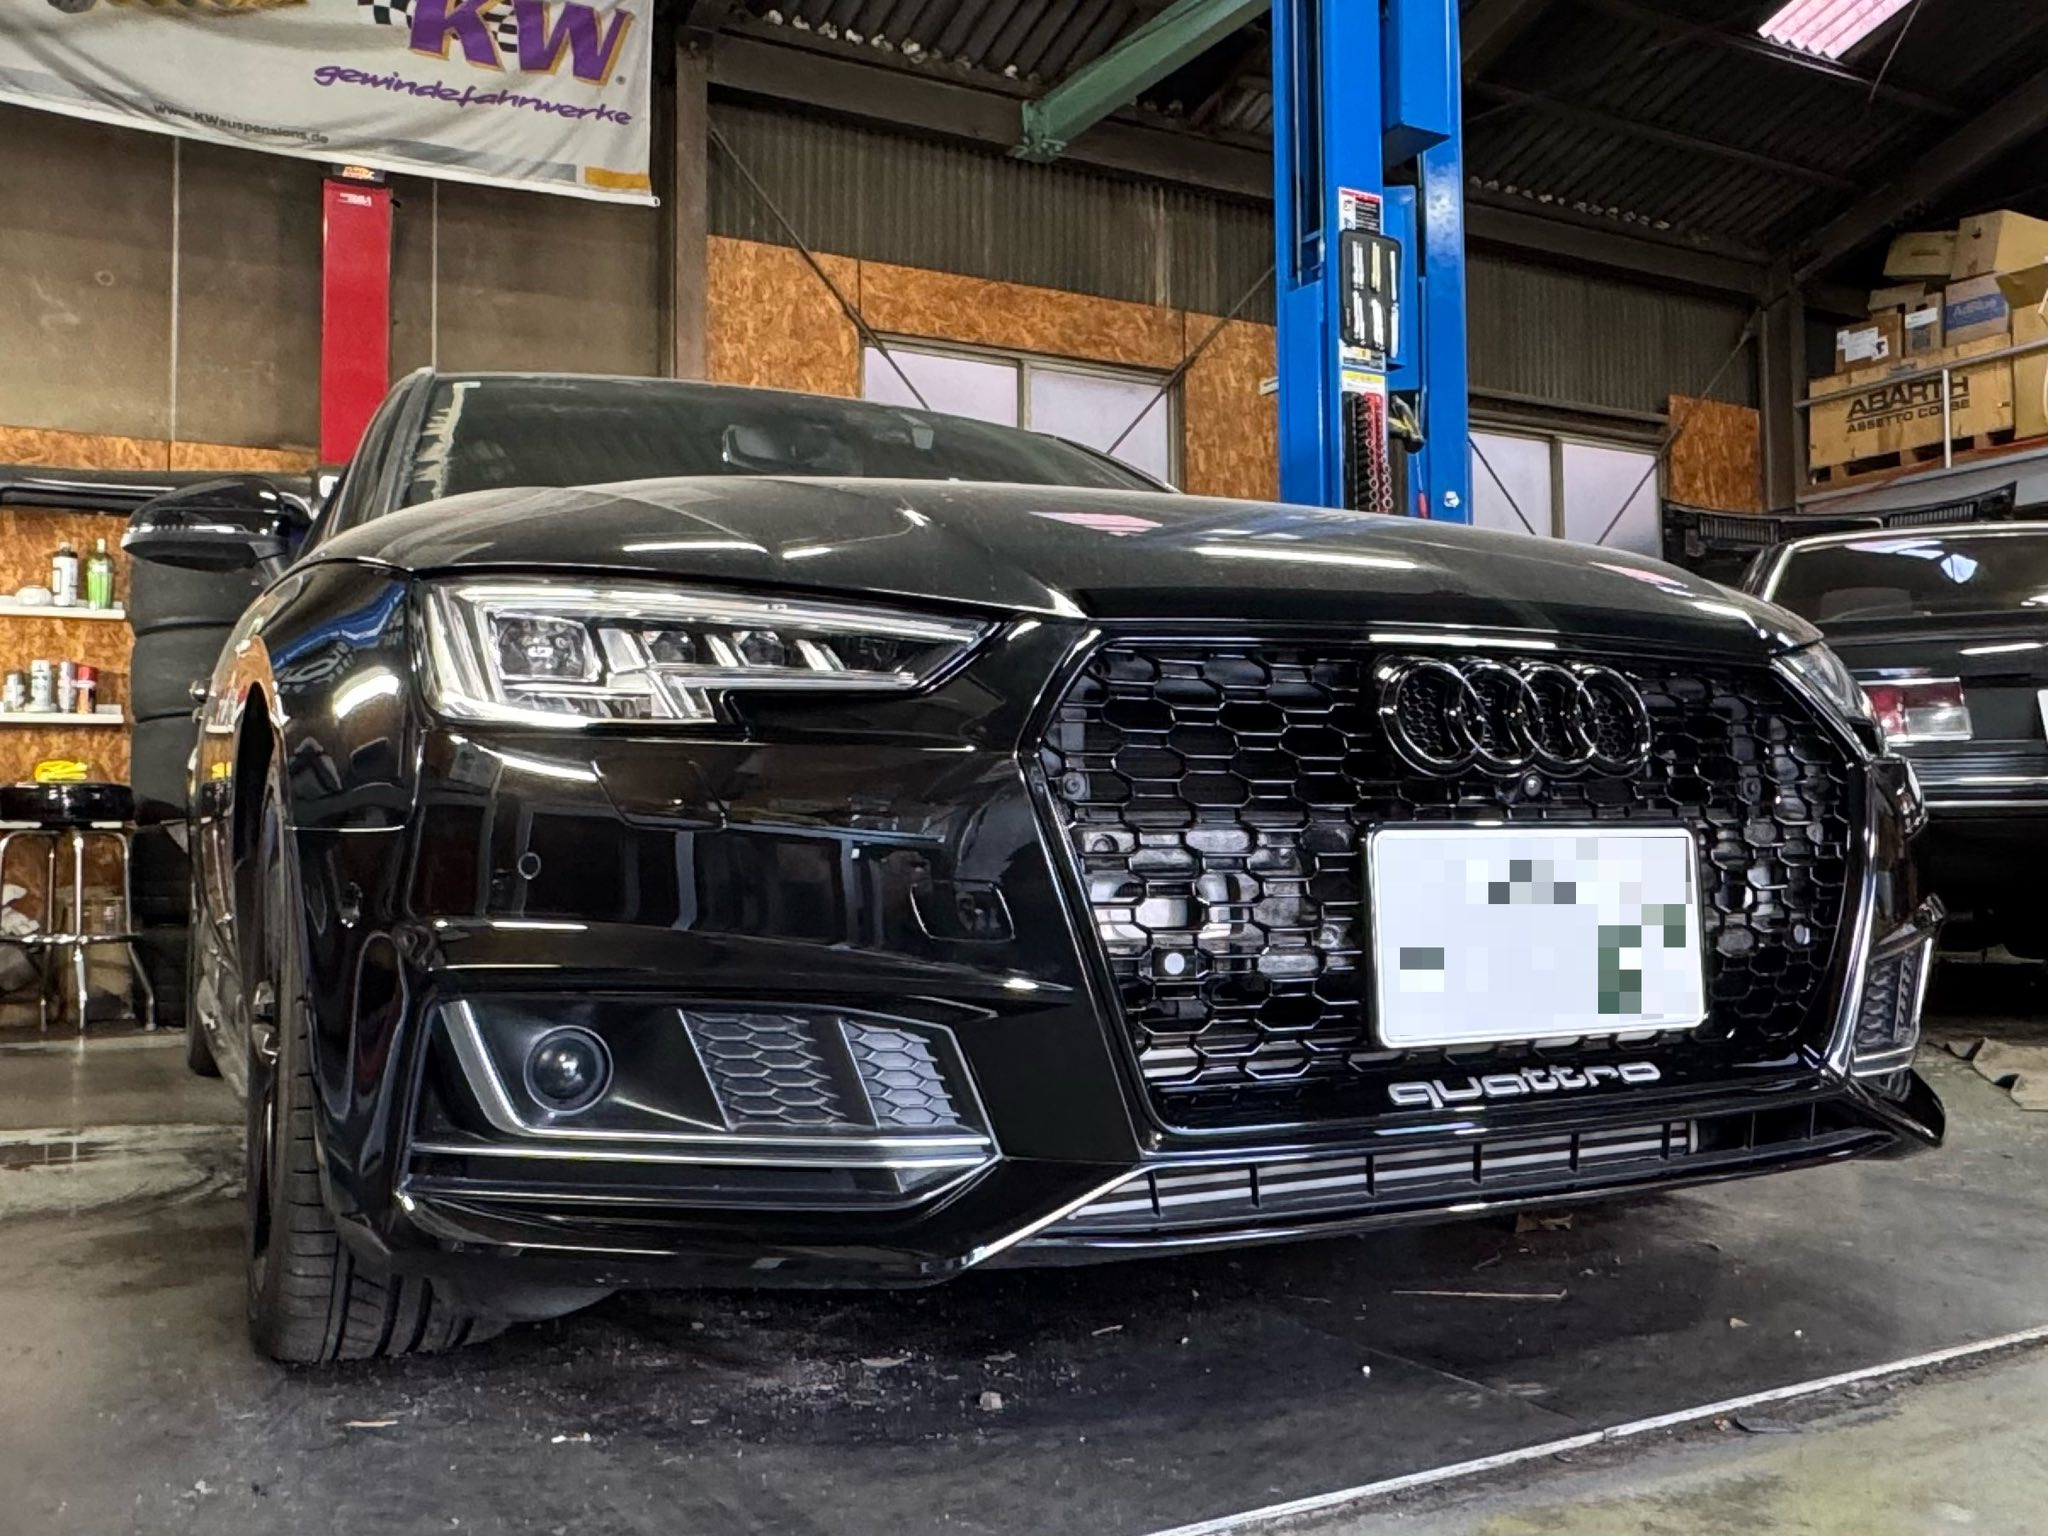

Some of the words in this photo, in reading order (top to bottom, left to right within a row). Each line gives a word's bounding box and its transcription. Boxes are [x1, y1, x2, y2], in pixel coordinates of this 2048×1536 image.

[409, 0, 635, 86] KW
[314, 65, 632, 126] gewindefahrwerke
[1846, 376, 1969, 420] ABARTH
[1847, 410, 1914, 434] ASSETTO
[1918, 398, 1971, 419] COSE
[1387, 1061, 1661, 1108] quattro
